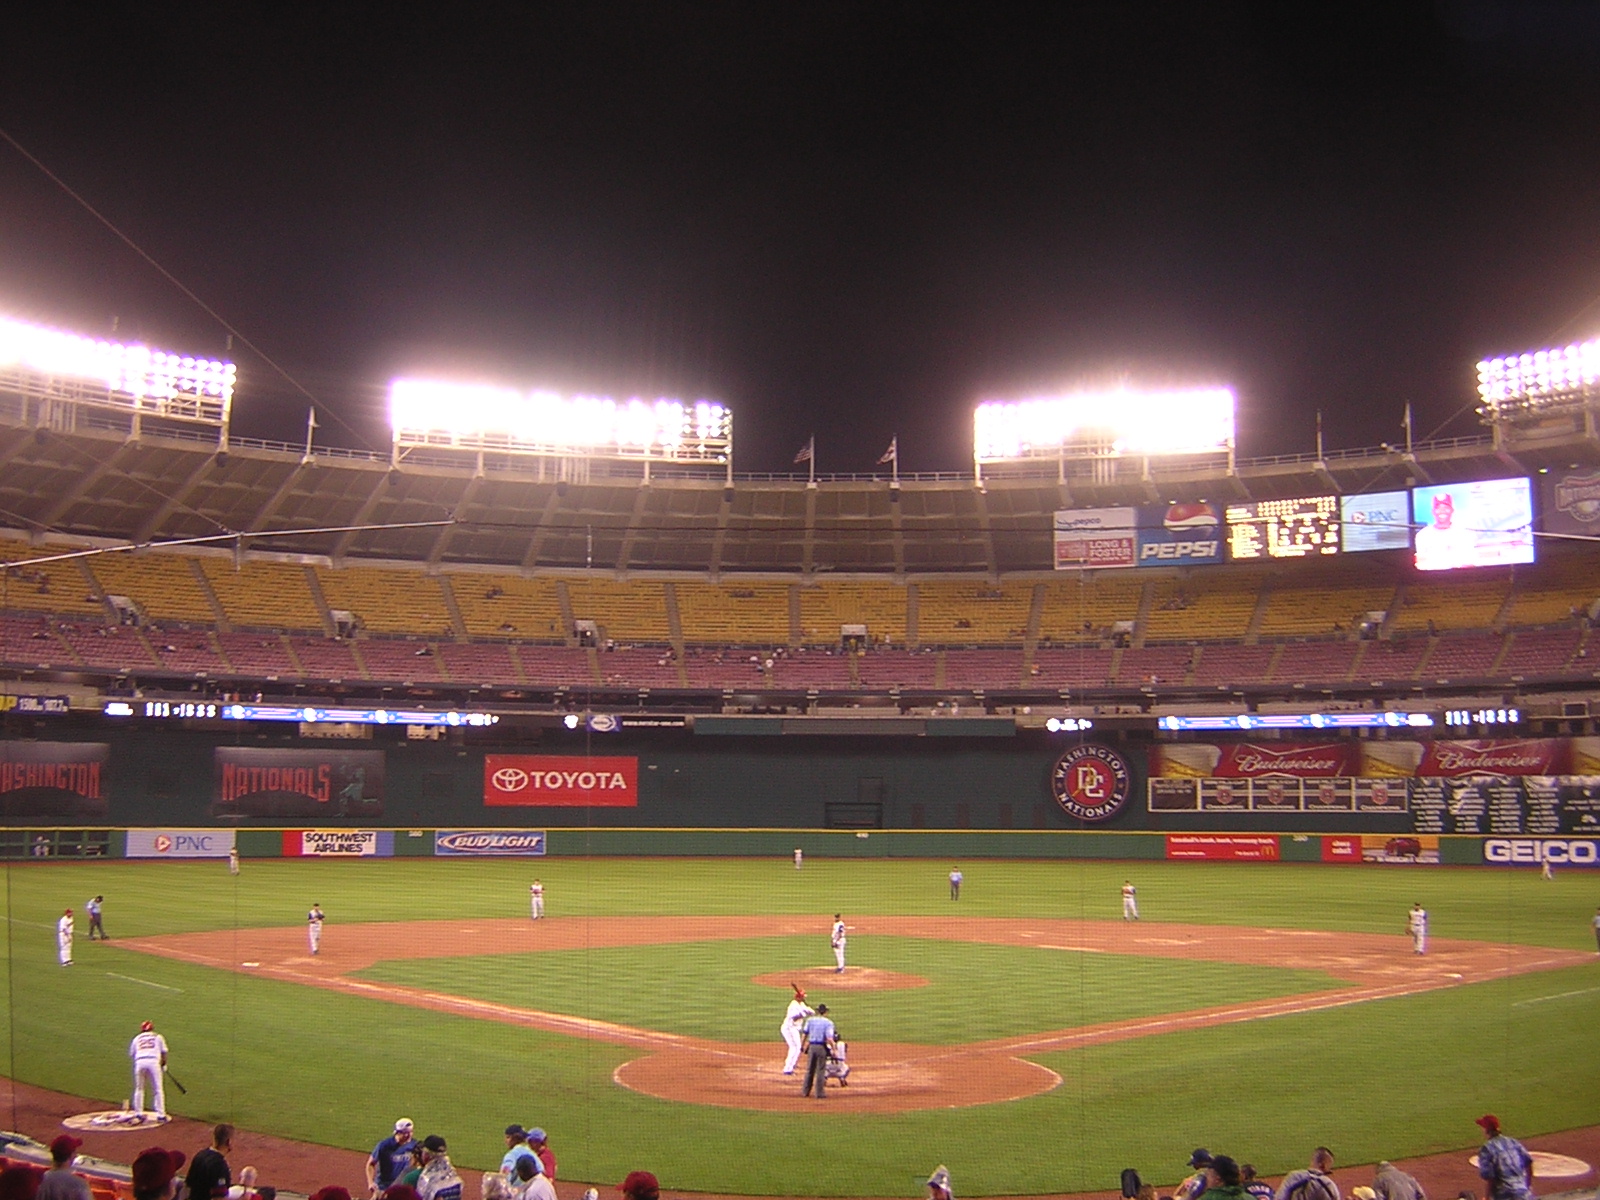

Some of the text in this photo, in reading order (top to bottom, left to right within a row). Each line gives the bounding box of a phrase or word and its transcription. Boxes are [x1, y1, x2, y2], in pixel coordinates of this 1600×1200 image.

[1368, 509, 1400, 522] PNC
[1089, 540, 1119, 549] LONG
[1089, 548, 1132, 558] FOSTER
[1140, 541, 1218, 560] PEPSI
[1055, 747, 1126, 778] WASHINGTON
[1235, 754, 1335, 772] Budweiser
[1436, 752, 1541, 769] Budweiser
[222, 763, 332, 802] NATIONALS
[530, 771, 627, 789] TOYOTA
[1076, 766, 1104, 798] DC
[1058, 792, 1122, 817] NATIONALS
[174, 836, 212, 851] PNC
[305, 833, 373, 843] SOUTHWEST
[454, 836, 541, 847] BUD LIGHT
[314, 843, 363, 853] AIRLINES
[1484, 840, 1597, 863] GEICO
[140, 1038, 156, 1049] 25
